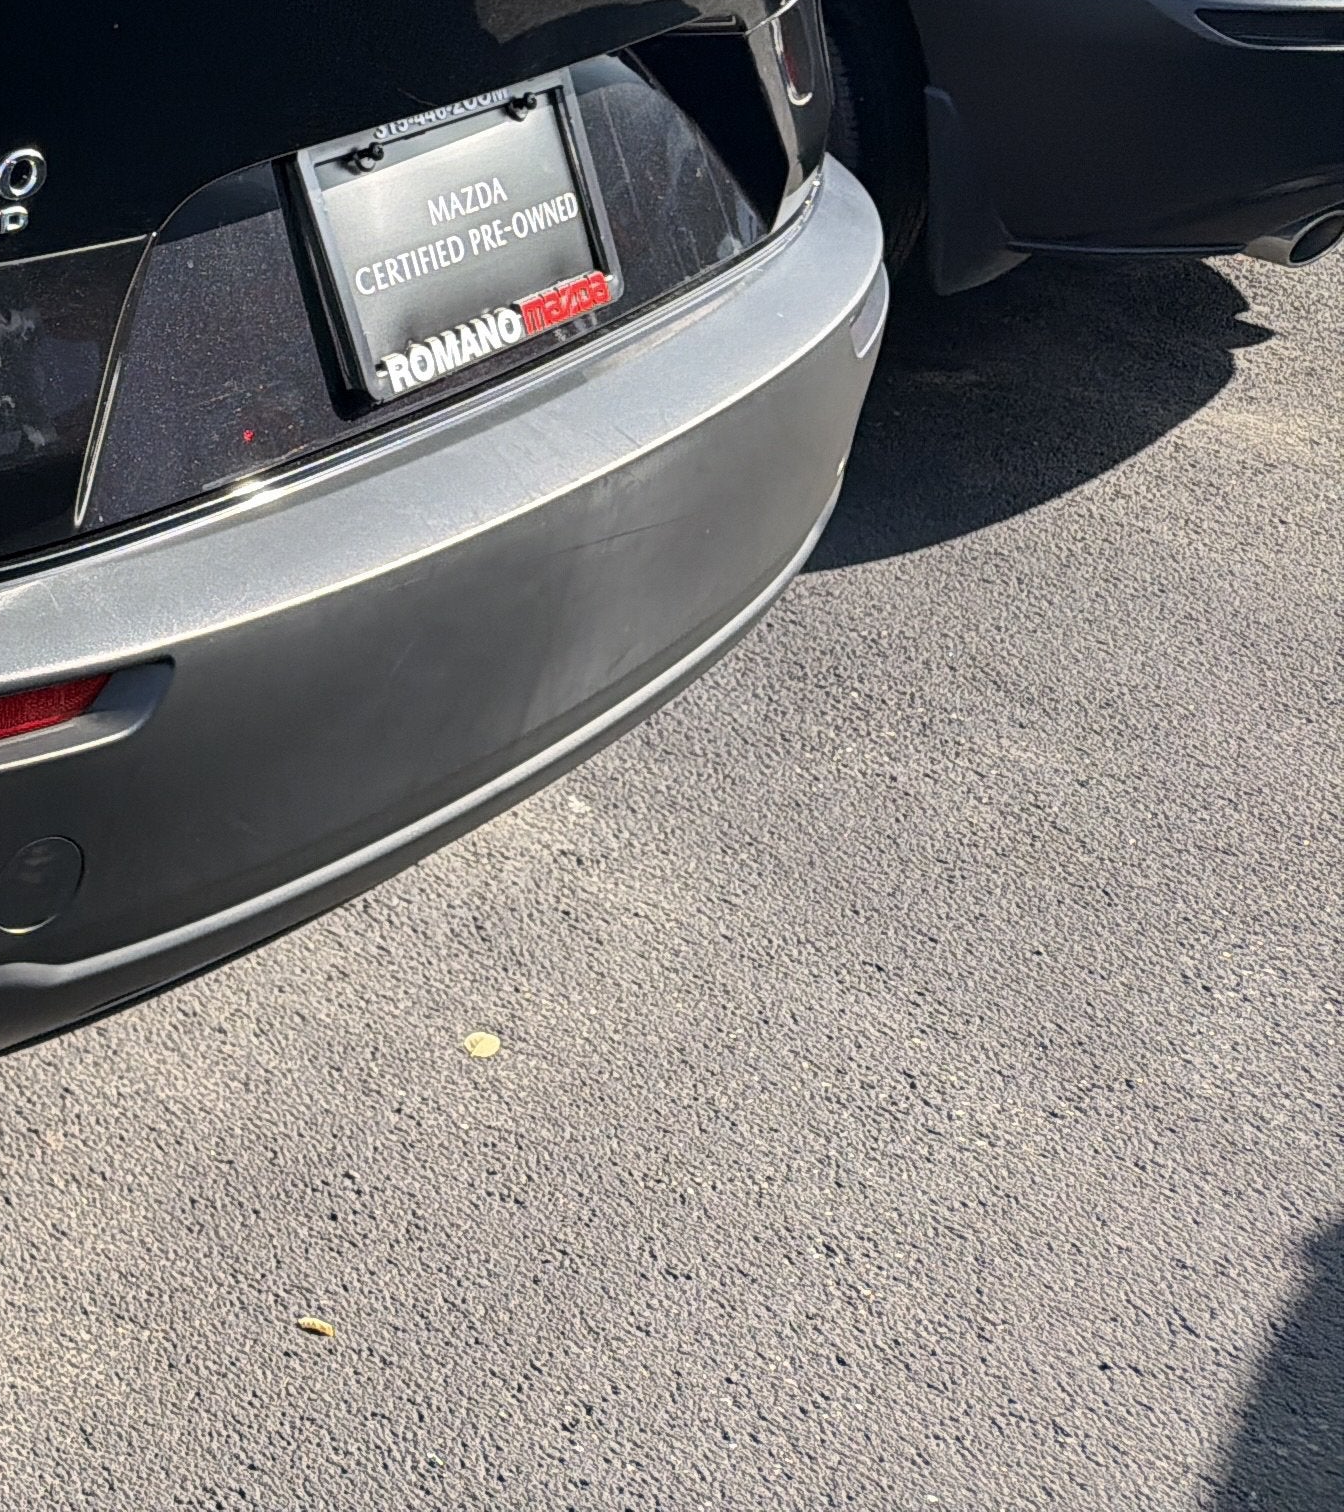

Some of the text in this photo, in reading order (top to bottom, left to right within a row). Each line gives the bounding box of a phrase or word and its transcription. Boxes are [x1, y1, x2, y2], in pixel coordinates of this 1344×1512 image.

[355, 192, 579, 295] CERTIFIED PRE-OWNED
[427, 177, 509, 226] MAZDA
[383, 307, 522, 393] ROMANO
